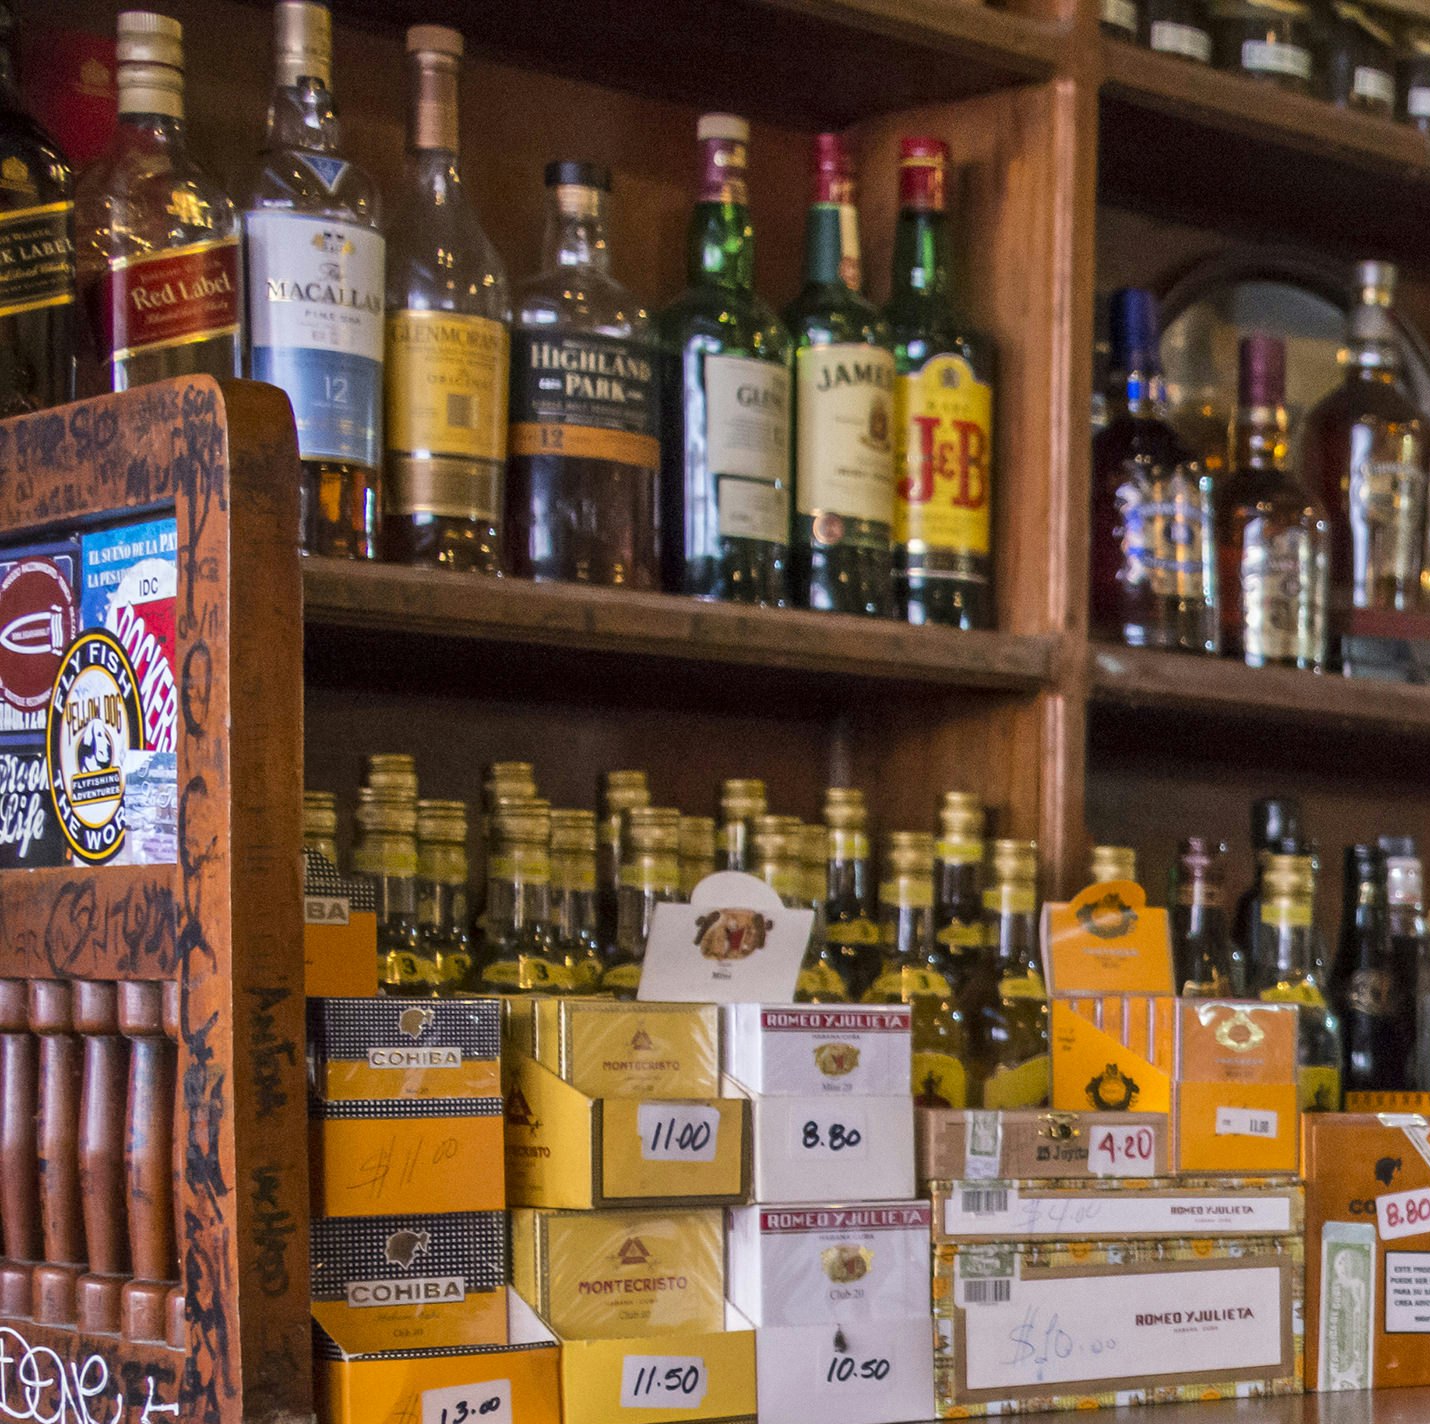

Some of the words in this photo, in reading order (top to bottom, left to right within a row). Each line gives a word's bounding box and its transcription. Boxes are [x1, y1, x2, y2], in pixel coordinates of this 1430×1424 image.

[132, 283, 177, 311] Red
[179, 271, 232, 303] Label
[324, 376, 349, 404] 12
[564, 373, 628, 402] PARK
[541, 427, 565, 450] 12
[89, 550, 99, 565] EL
[102, 544, 131, 563] SUEÑO
[133, 543, 144, 560] DE
[145, 540, 157, 557] LA
[139, 577, 159, 597] IDC
[54, 651, 81, 713] FLY
[73, 775, 120, 790] FLYFISHING
[72, 786, 120, 801] ADVENTURES
[85, 806, 127, 850] WOR
[306, 901, 347, 921] BA
[402, 957, 417, 976] 3
[534, 963, 550, 980] 3
[766, 1014, 820, 1027] ROMEO
[372, 1048, 461, 1069] COHIBA
[602, 1060, 681, 1072] MONTECRISTO
[801, 1121, 861, 1151] 8.80
[1099, 1127, 1153, 1163] 4.20
[767, 1213, 828, 1229] ROMEO
[1170, 1205, 1204, 1216] ROMEO
[350, 1282, 464, 1305] COHIBA
[577, 1275, 689, 1295] MONTECRISTO
[1136, 1311, 1182, 1327] ROMEO
[634, 1364, 700, 1397] 11.50
[826, 1357, 890, 1383] 10.50
